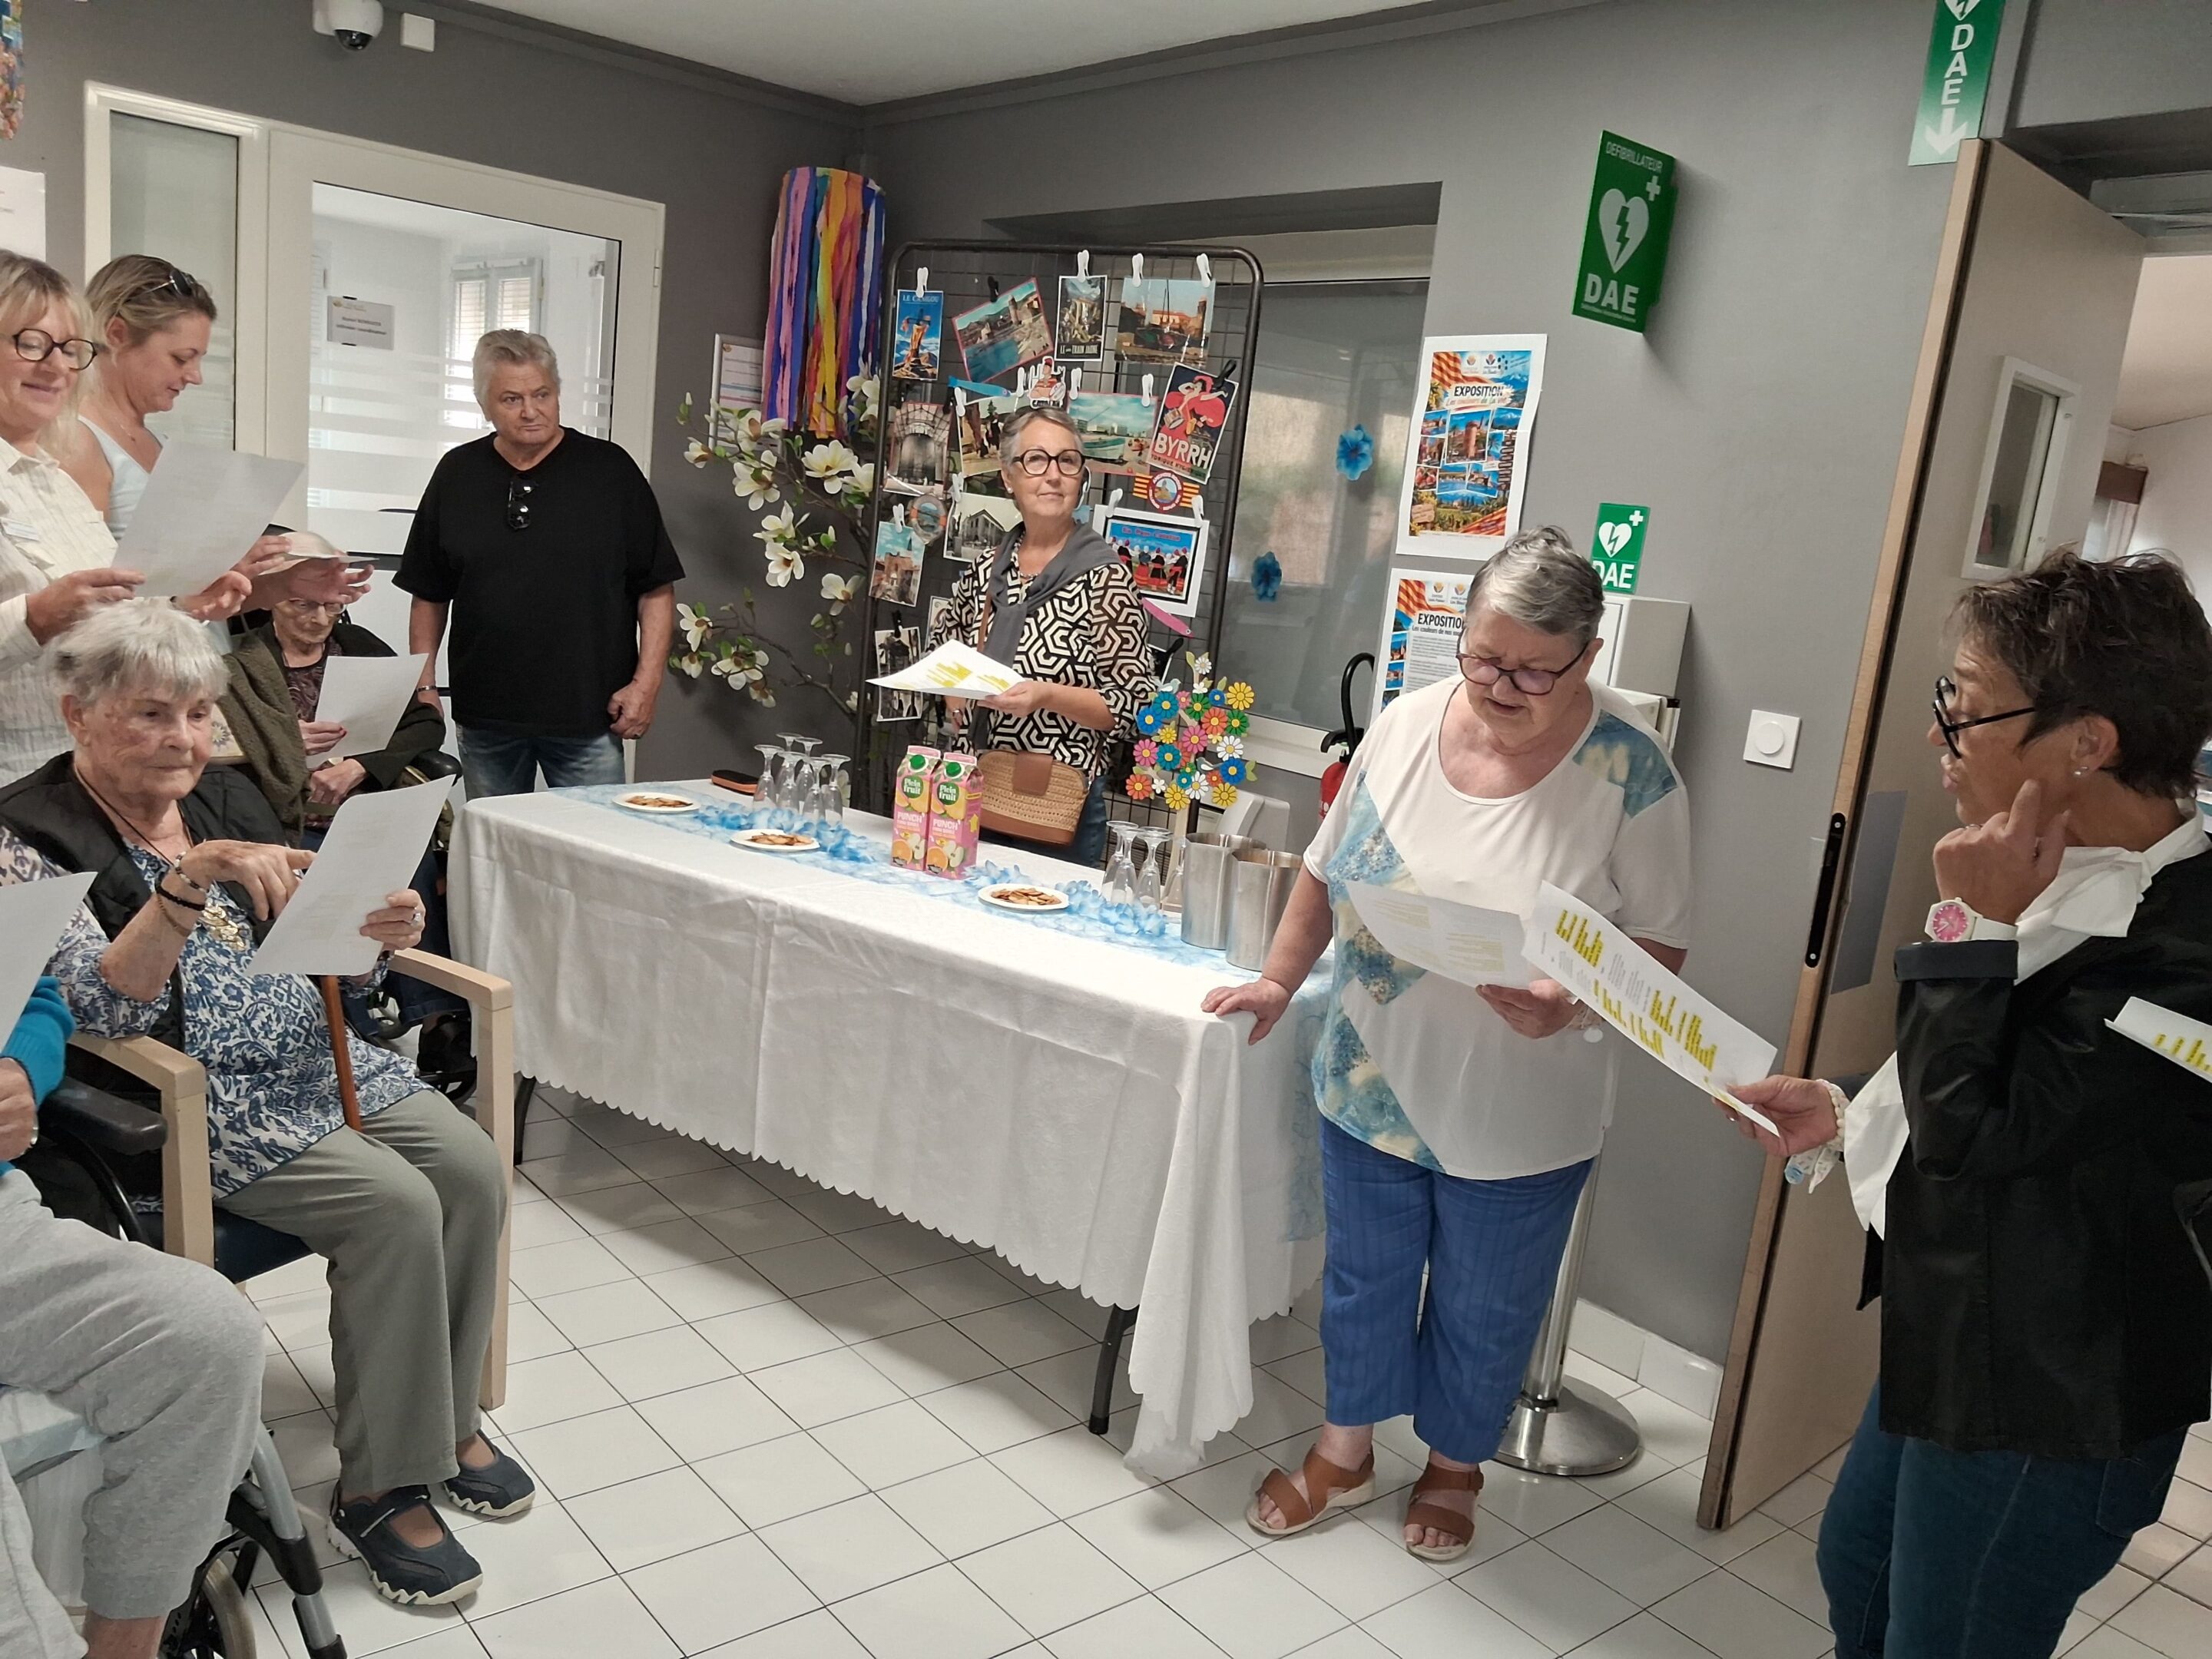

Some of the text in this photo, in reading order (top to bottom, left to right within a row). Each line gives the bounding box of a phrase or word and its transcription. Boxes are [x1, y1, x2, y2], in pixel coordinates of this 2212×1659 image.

[1941, 24, 1975, 105] DAE
[1584, 273, 1640, 316] DAE
[1454, 386, 1505, 397] EXPOSITION
[1154, 432, 1213, 470] BYRRH
[1592, 560, 1635, 589] DAE
[1418, 613, 1464, 630] EXPOSITIO
[904, 778, 921, 787] Plein
[903, 784, 921, 795] fruit
[939, 784, 956, 794] Plein
[939, 791, 956, 801] fruit
[897, 811, 922, 823] PUNCH
[932, 819, 959, 830] PUNCH
